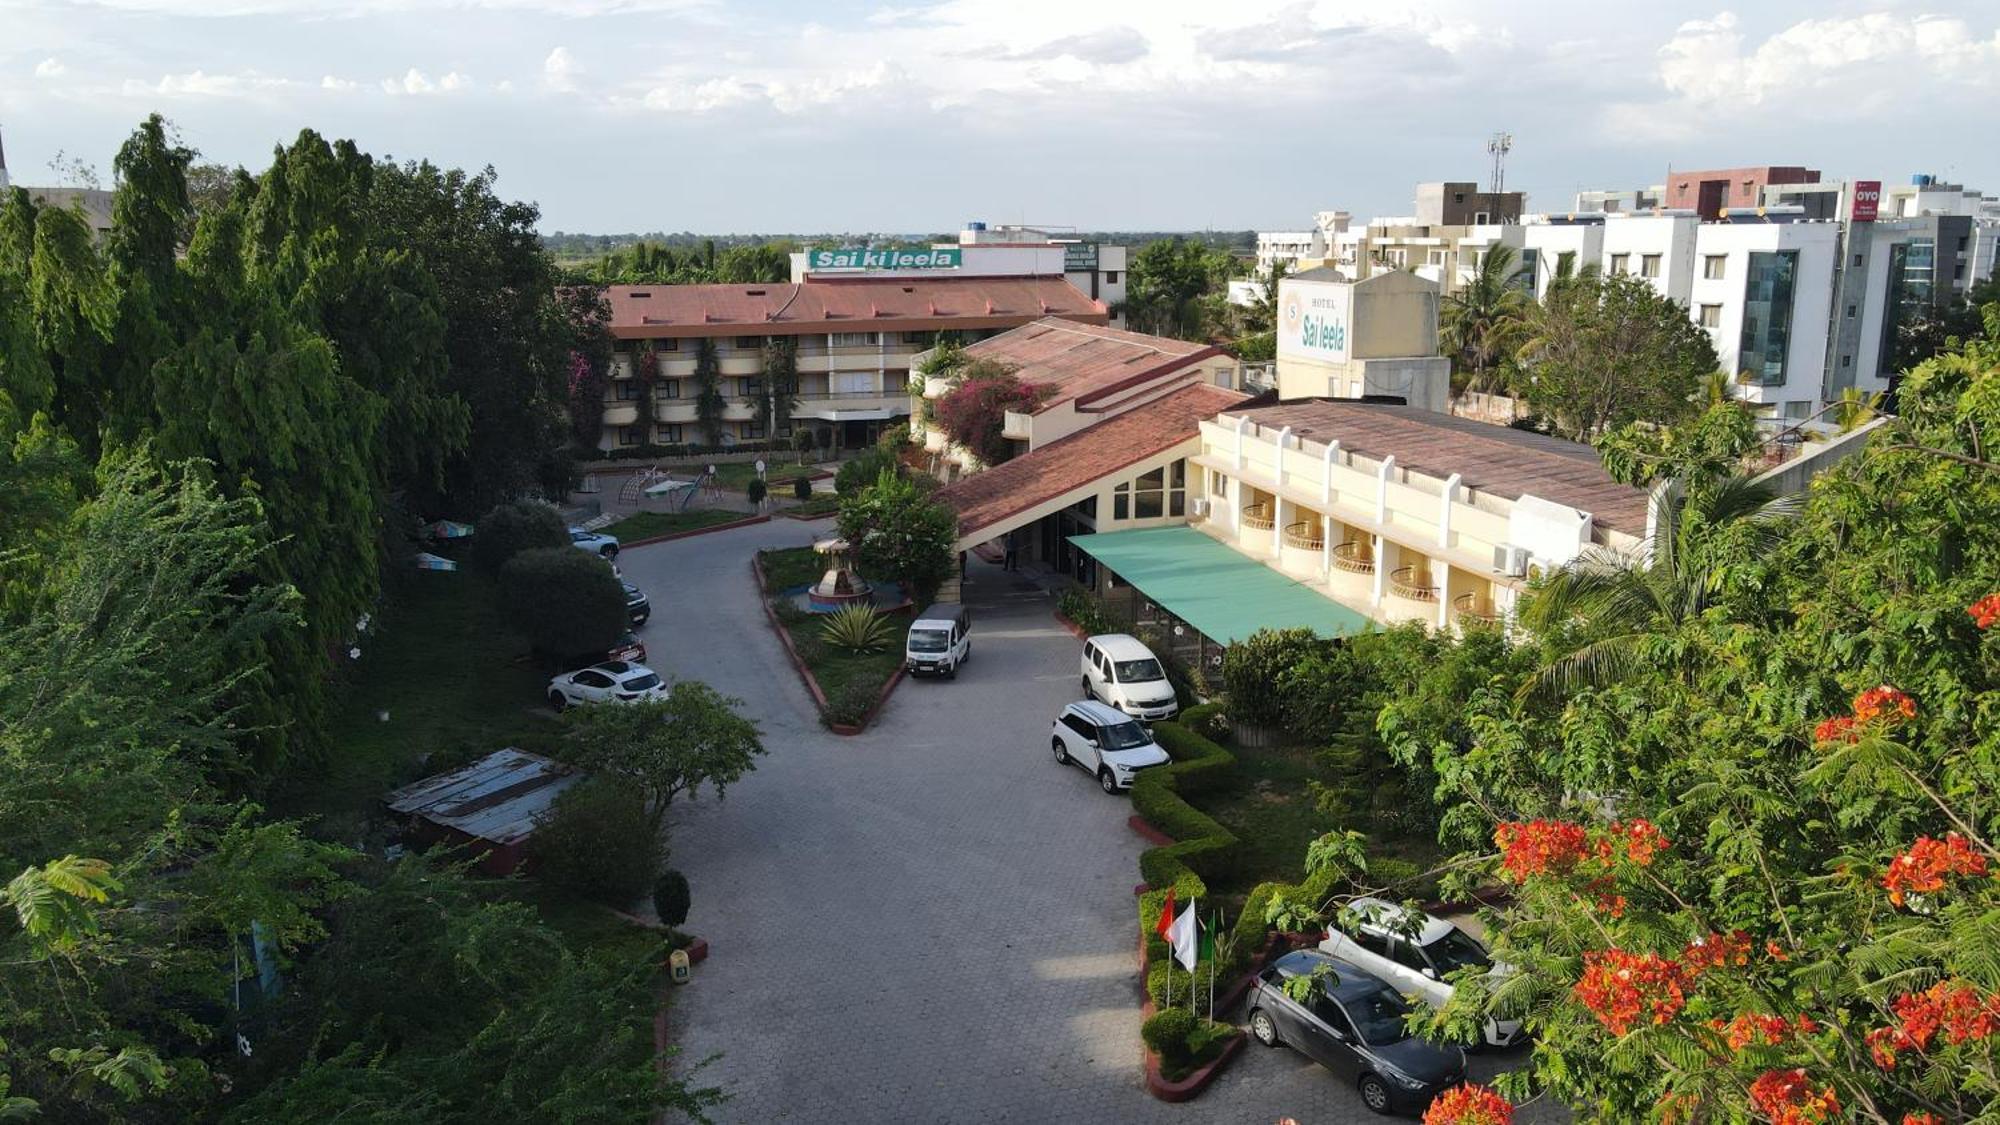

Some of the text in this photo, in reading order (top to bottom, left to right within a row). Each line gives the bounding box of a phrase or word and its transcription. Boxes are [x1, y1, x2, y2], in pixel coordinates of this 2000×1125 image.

[1857, 192, 1877, 201] OYO
[816, 251, 951, 266] Sai ki leela
[1312, 298, 1335, 309] HOTEL
